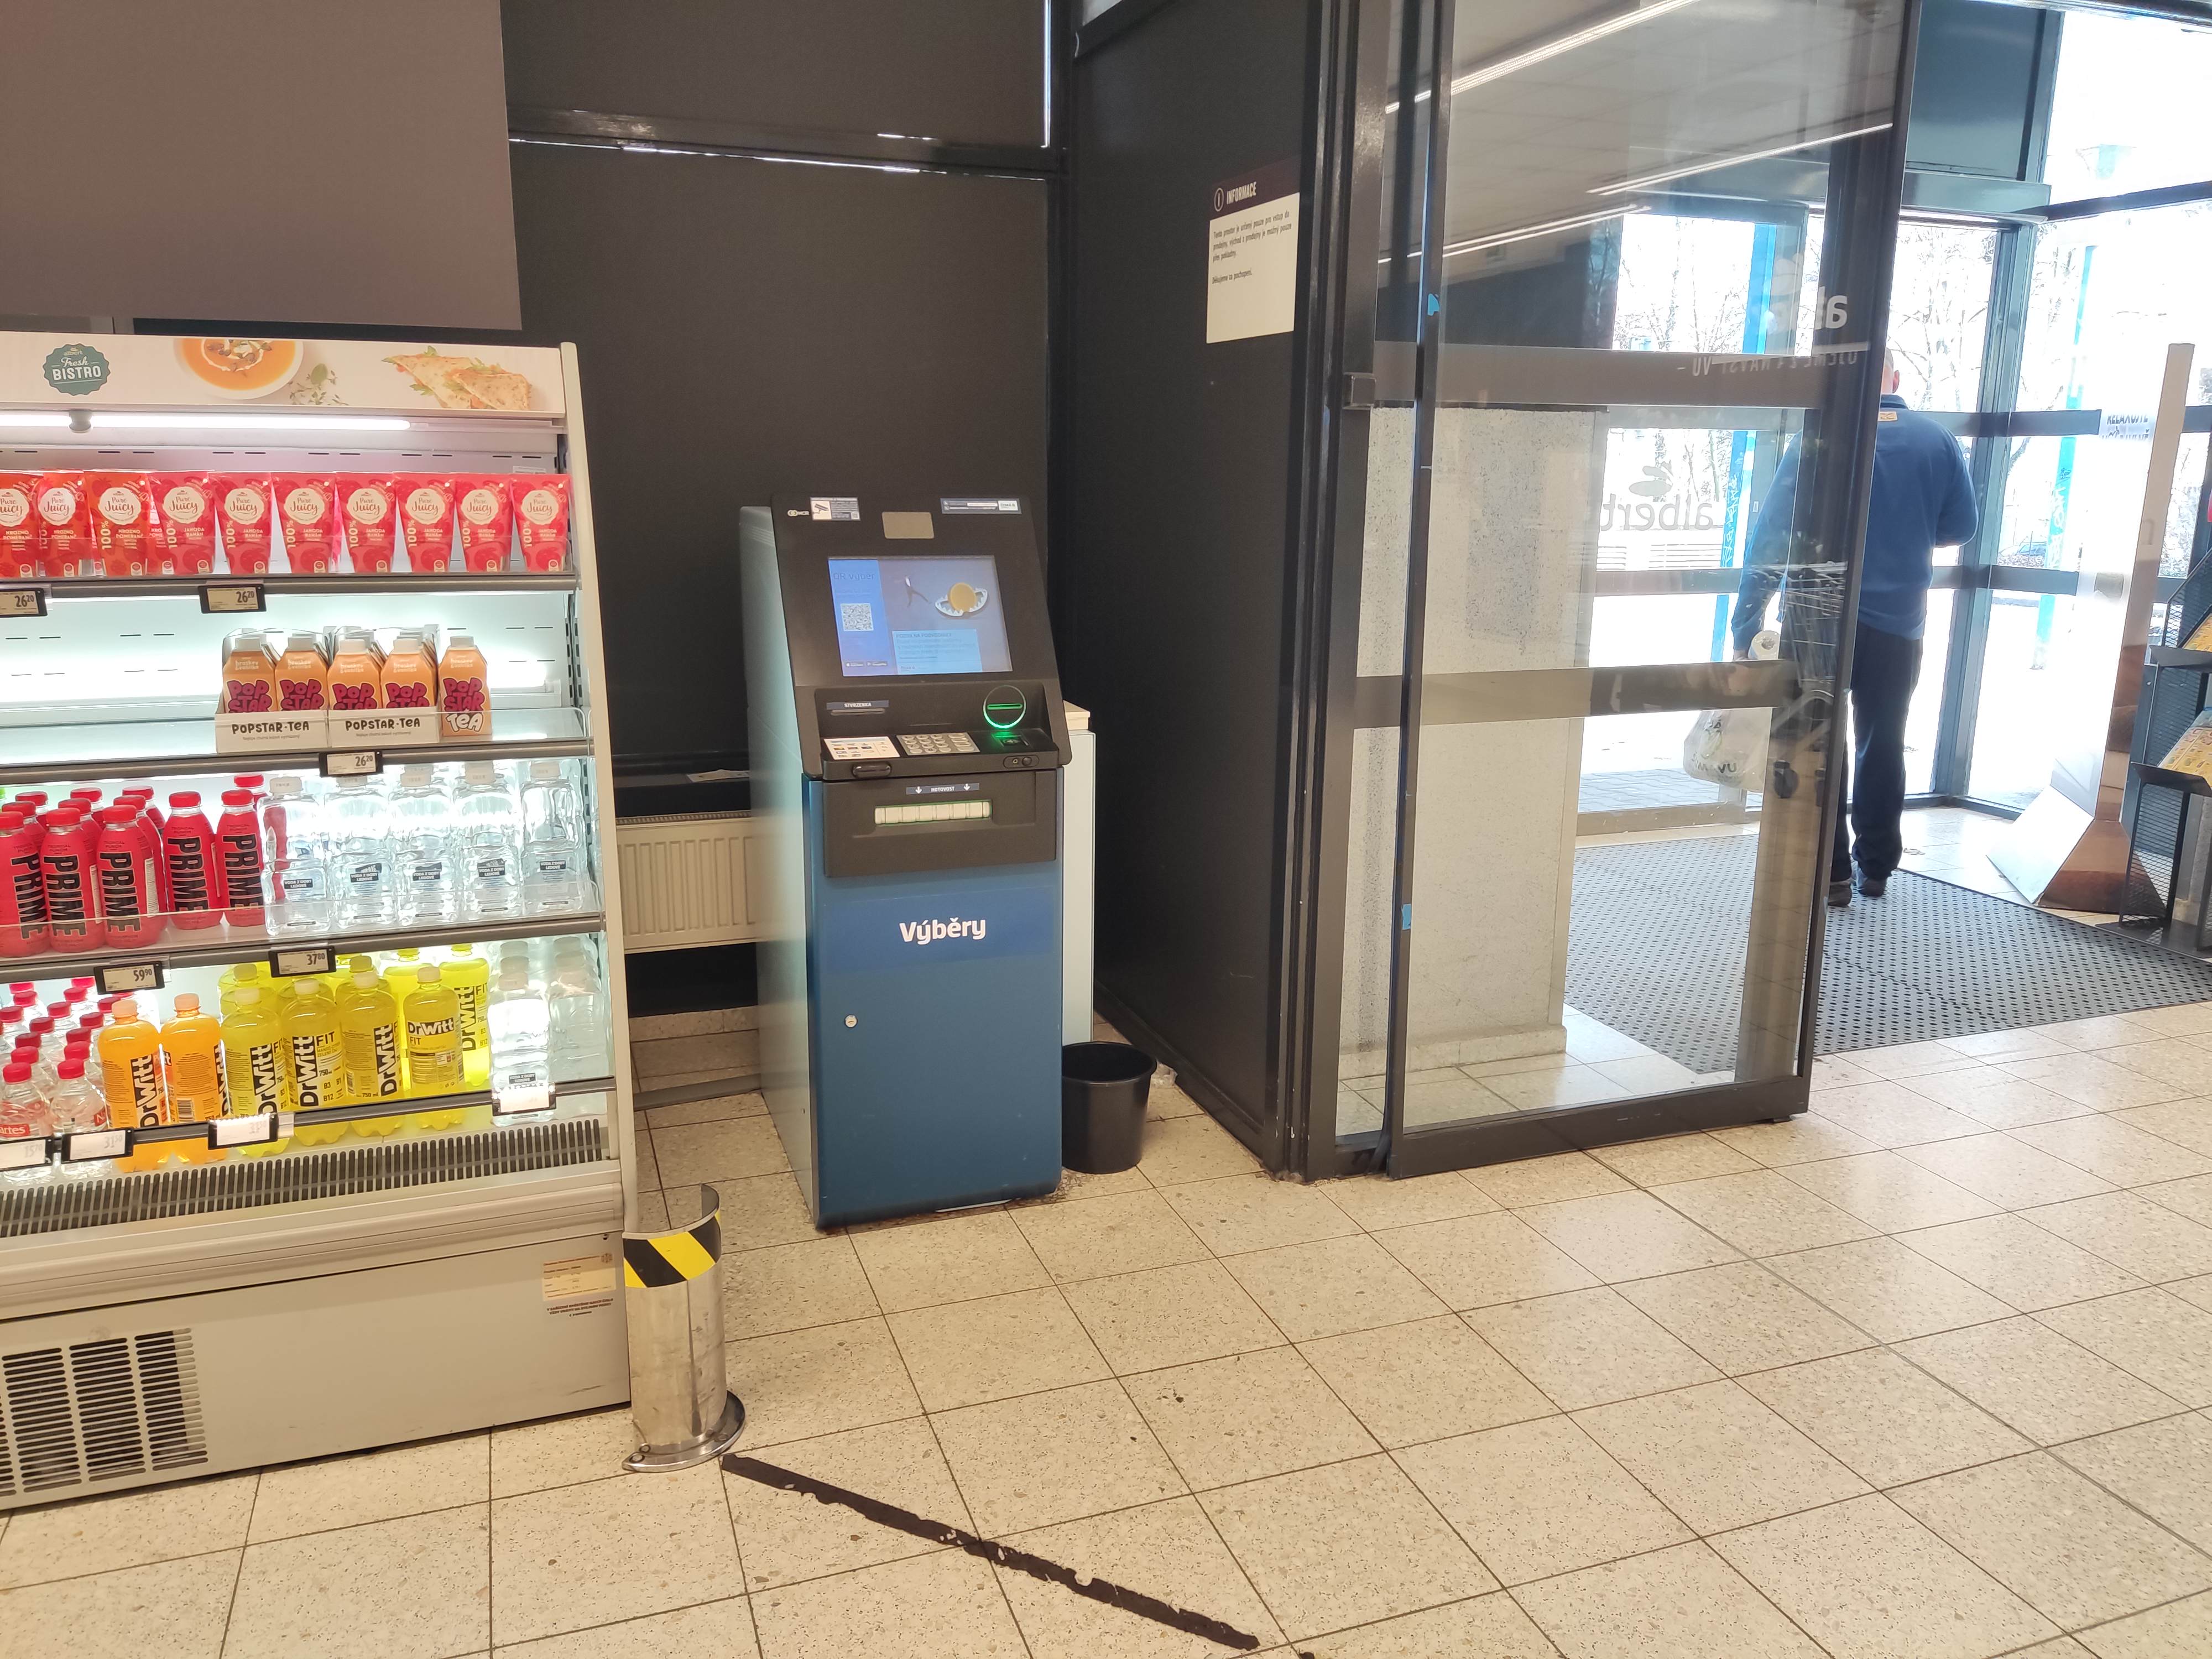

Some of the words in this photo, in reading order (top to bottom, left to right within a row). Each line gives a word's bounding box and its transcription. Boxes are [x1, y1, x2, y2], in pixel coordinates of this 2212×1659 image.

[1227, 181, 1257, 205] INFORMACE
[61, 357, 88, 367] Fresh
[52, 366, 101, 380] BISTRO
[0, 503, 23, 516] uicy
[44, 500, 69, 515] Juicy
[105, 500, 134, 515] Juicy
[169, 501, 198, 516] Juicy
[230, 502, 257, 515] Juicy
[290, 501, 319, 515] Juicy
[353, 502, 380, 515] Juicy
[412, 502, 439, 515] Juicy
[467, 502, 492, 515] Juicy
[527, 503, 552, 516] Juicy
[101, 520, 112, 550] 100%
[166, 520, 177, 549] 100%
[226, 520, 236, 549] 100%
[286, 520, 296, 548] 100%
[348, 520, 358, 547] 100%
[407, 520, 417, 547] 100%
[463, 521, 471, 547] 100%
[523, 521, 532, 548] 100%
[227, 680, 269, 699] POP
[280, 679, 321, 698] POP
[332, 683, 374, 702] POP
[385, 682, 427, 701] POP
[443, 677, 482, 696] POP
[228, 694, 272, 712] STAR
[281, 693, 324, 711] STAR
[444, 692, 485, 711] STAR
[168, 836, 208, 912] PRIME
[223, 834, 264, 911] PRIME
[11, 853, 48, 939] PRIME
[44, 854, 86, 936] PRIME
[100, 851, 140, 932] PRIME
[899, 917, 986, 945] Výběry
[408, 1018, 454, 1035] DrWitt
[316, 1031, 335, 1047] FIT
[410, 1037, 421, 1045] FIT
[373, 1023, 398, 1097] DrWitt
[292, 1036, 319, 1107] DrWitt
[0, 1125, 26, 1136] artes
